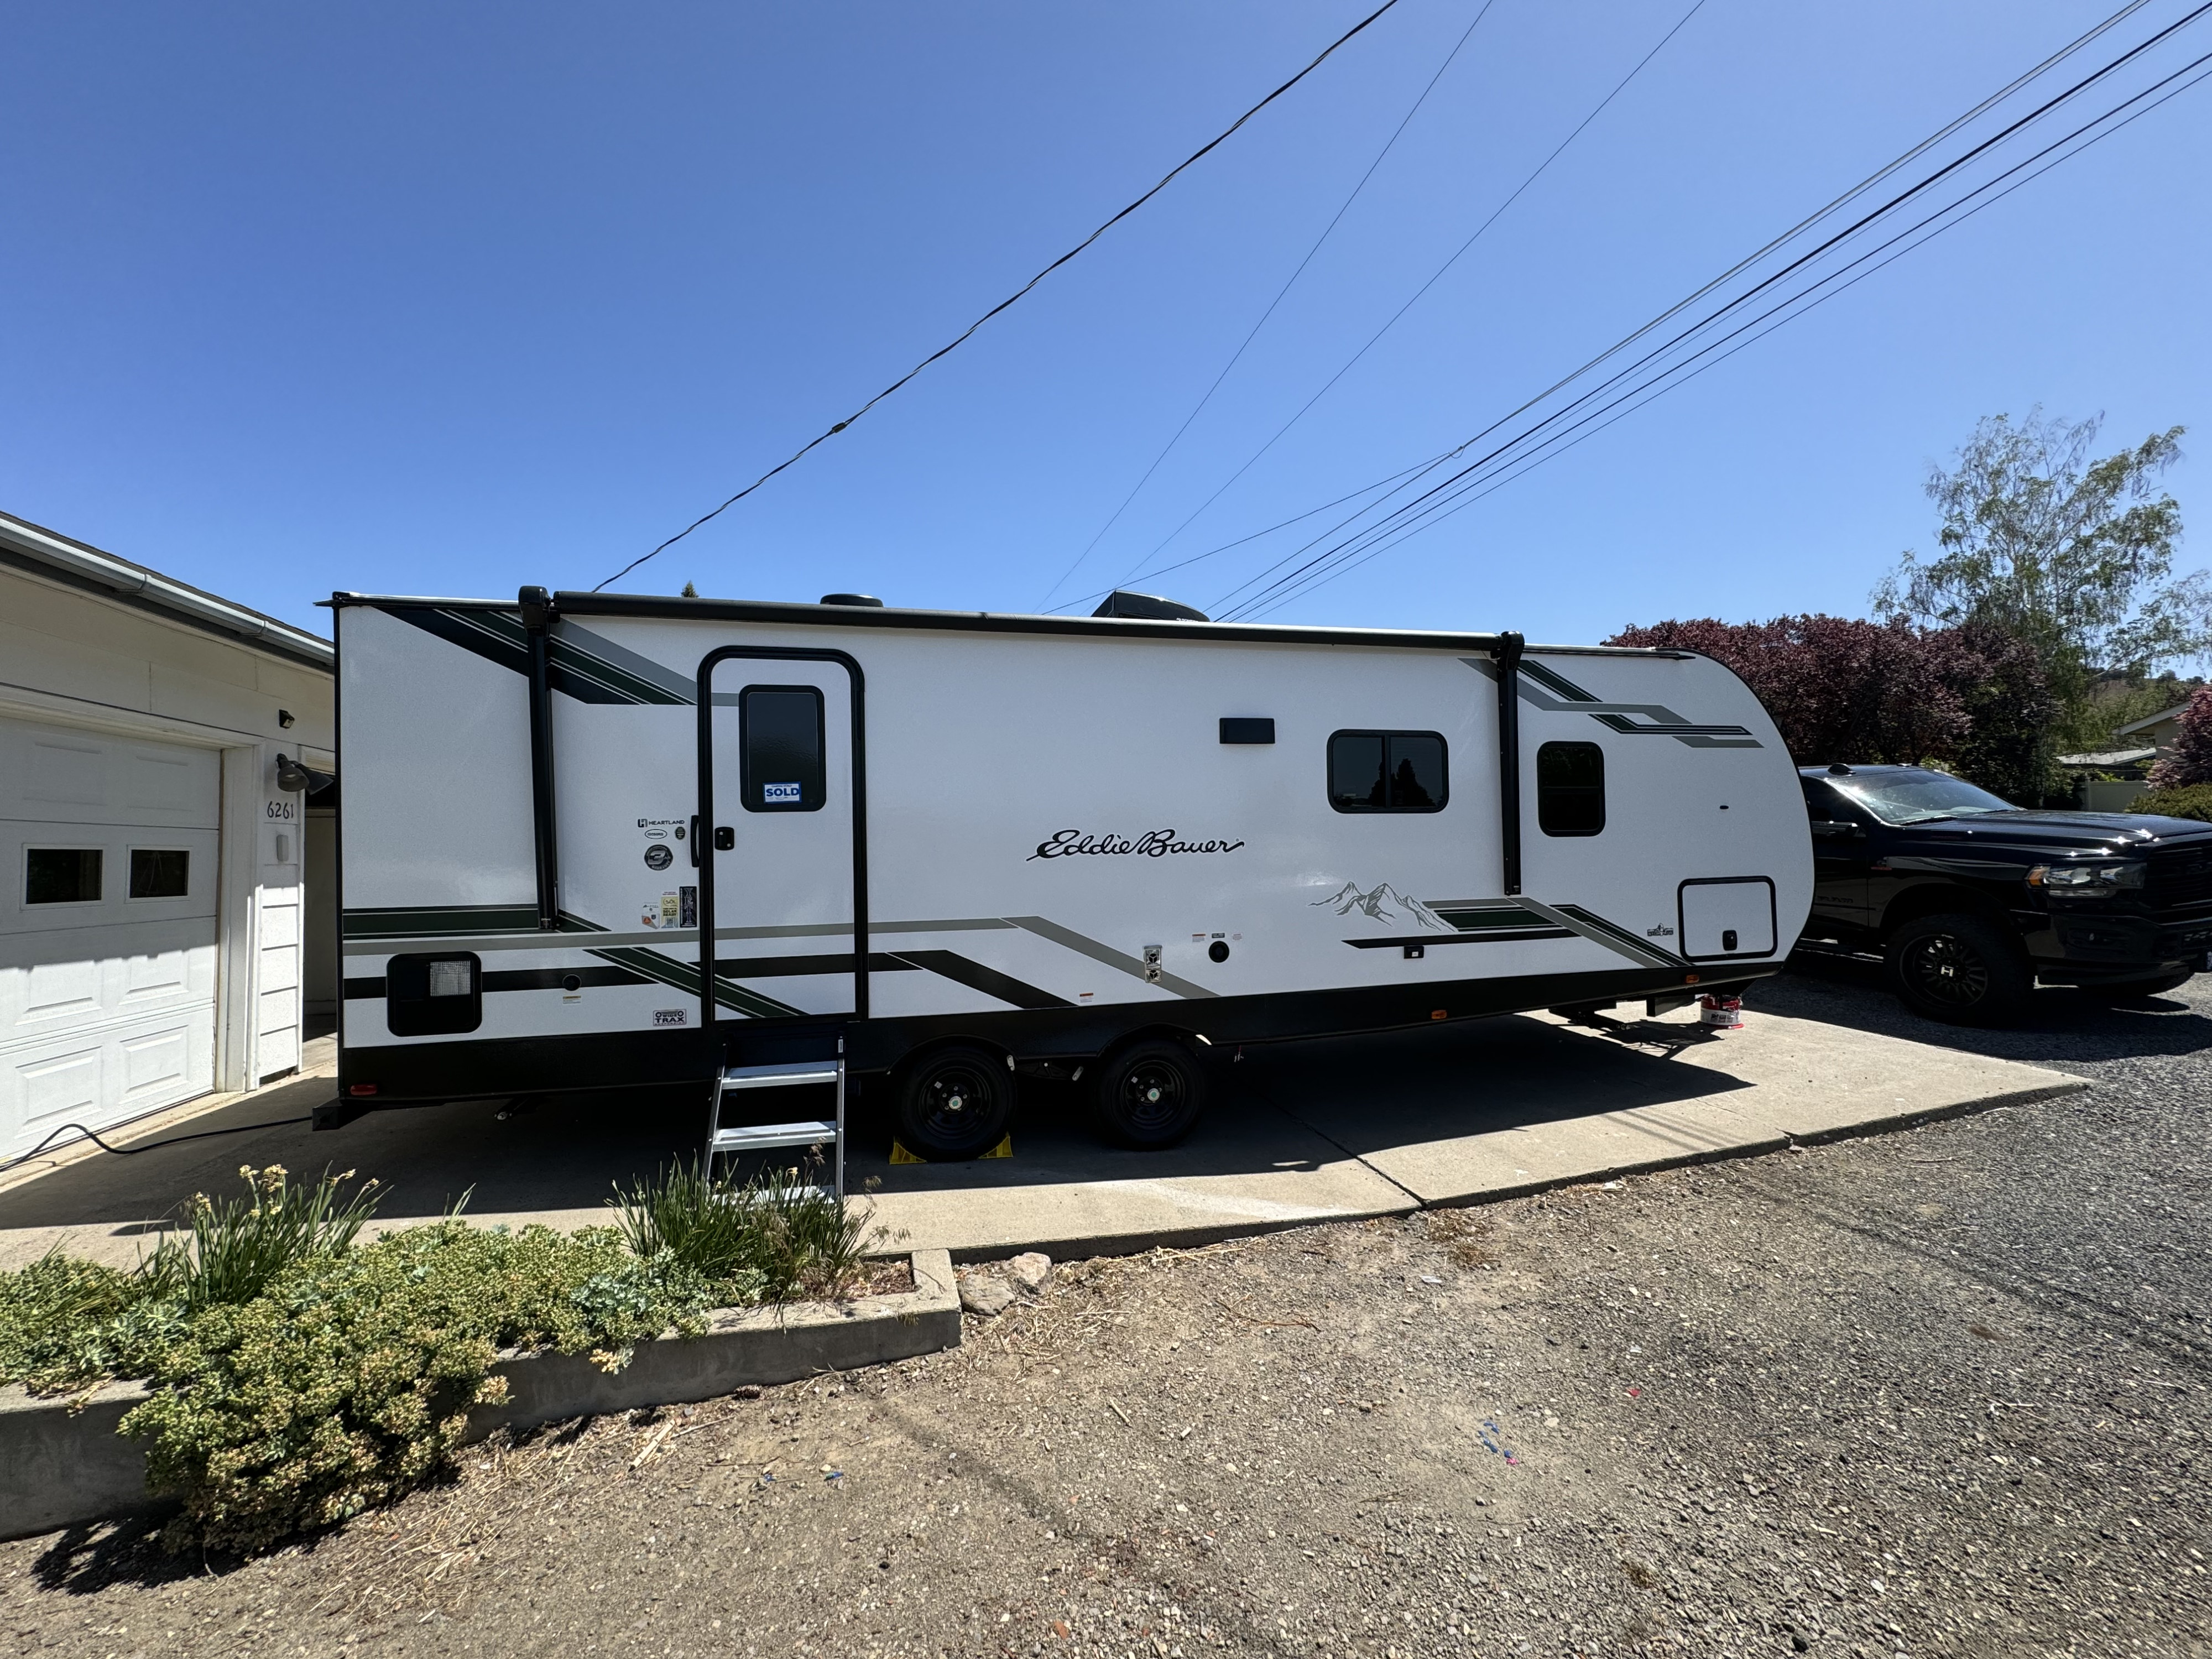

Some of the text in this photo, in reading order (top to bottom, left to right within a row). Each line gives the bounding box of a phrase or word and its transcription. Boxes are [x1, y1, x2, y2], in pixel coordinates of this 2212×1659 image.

[765, 787, 800, 797] SOLD
[267, 800, 294, 819] 6261
[1026, 828, 1245, 862] Eddie Bauer
[648, 850, 666, 865] 3
[684, 888, 693, 923] YETI
